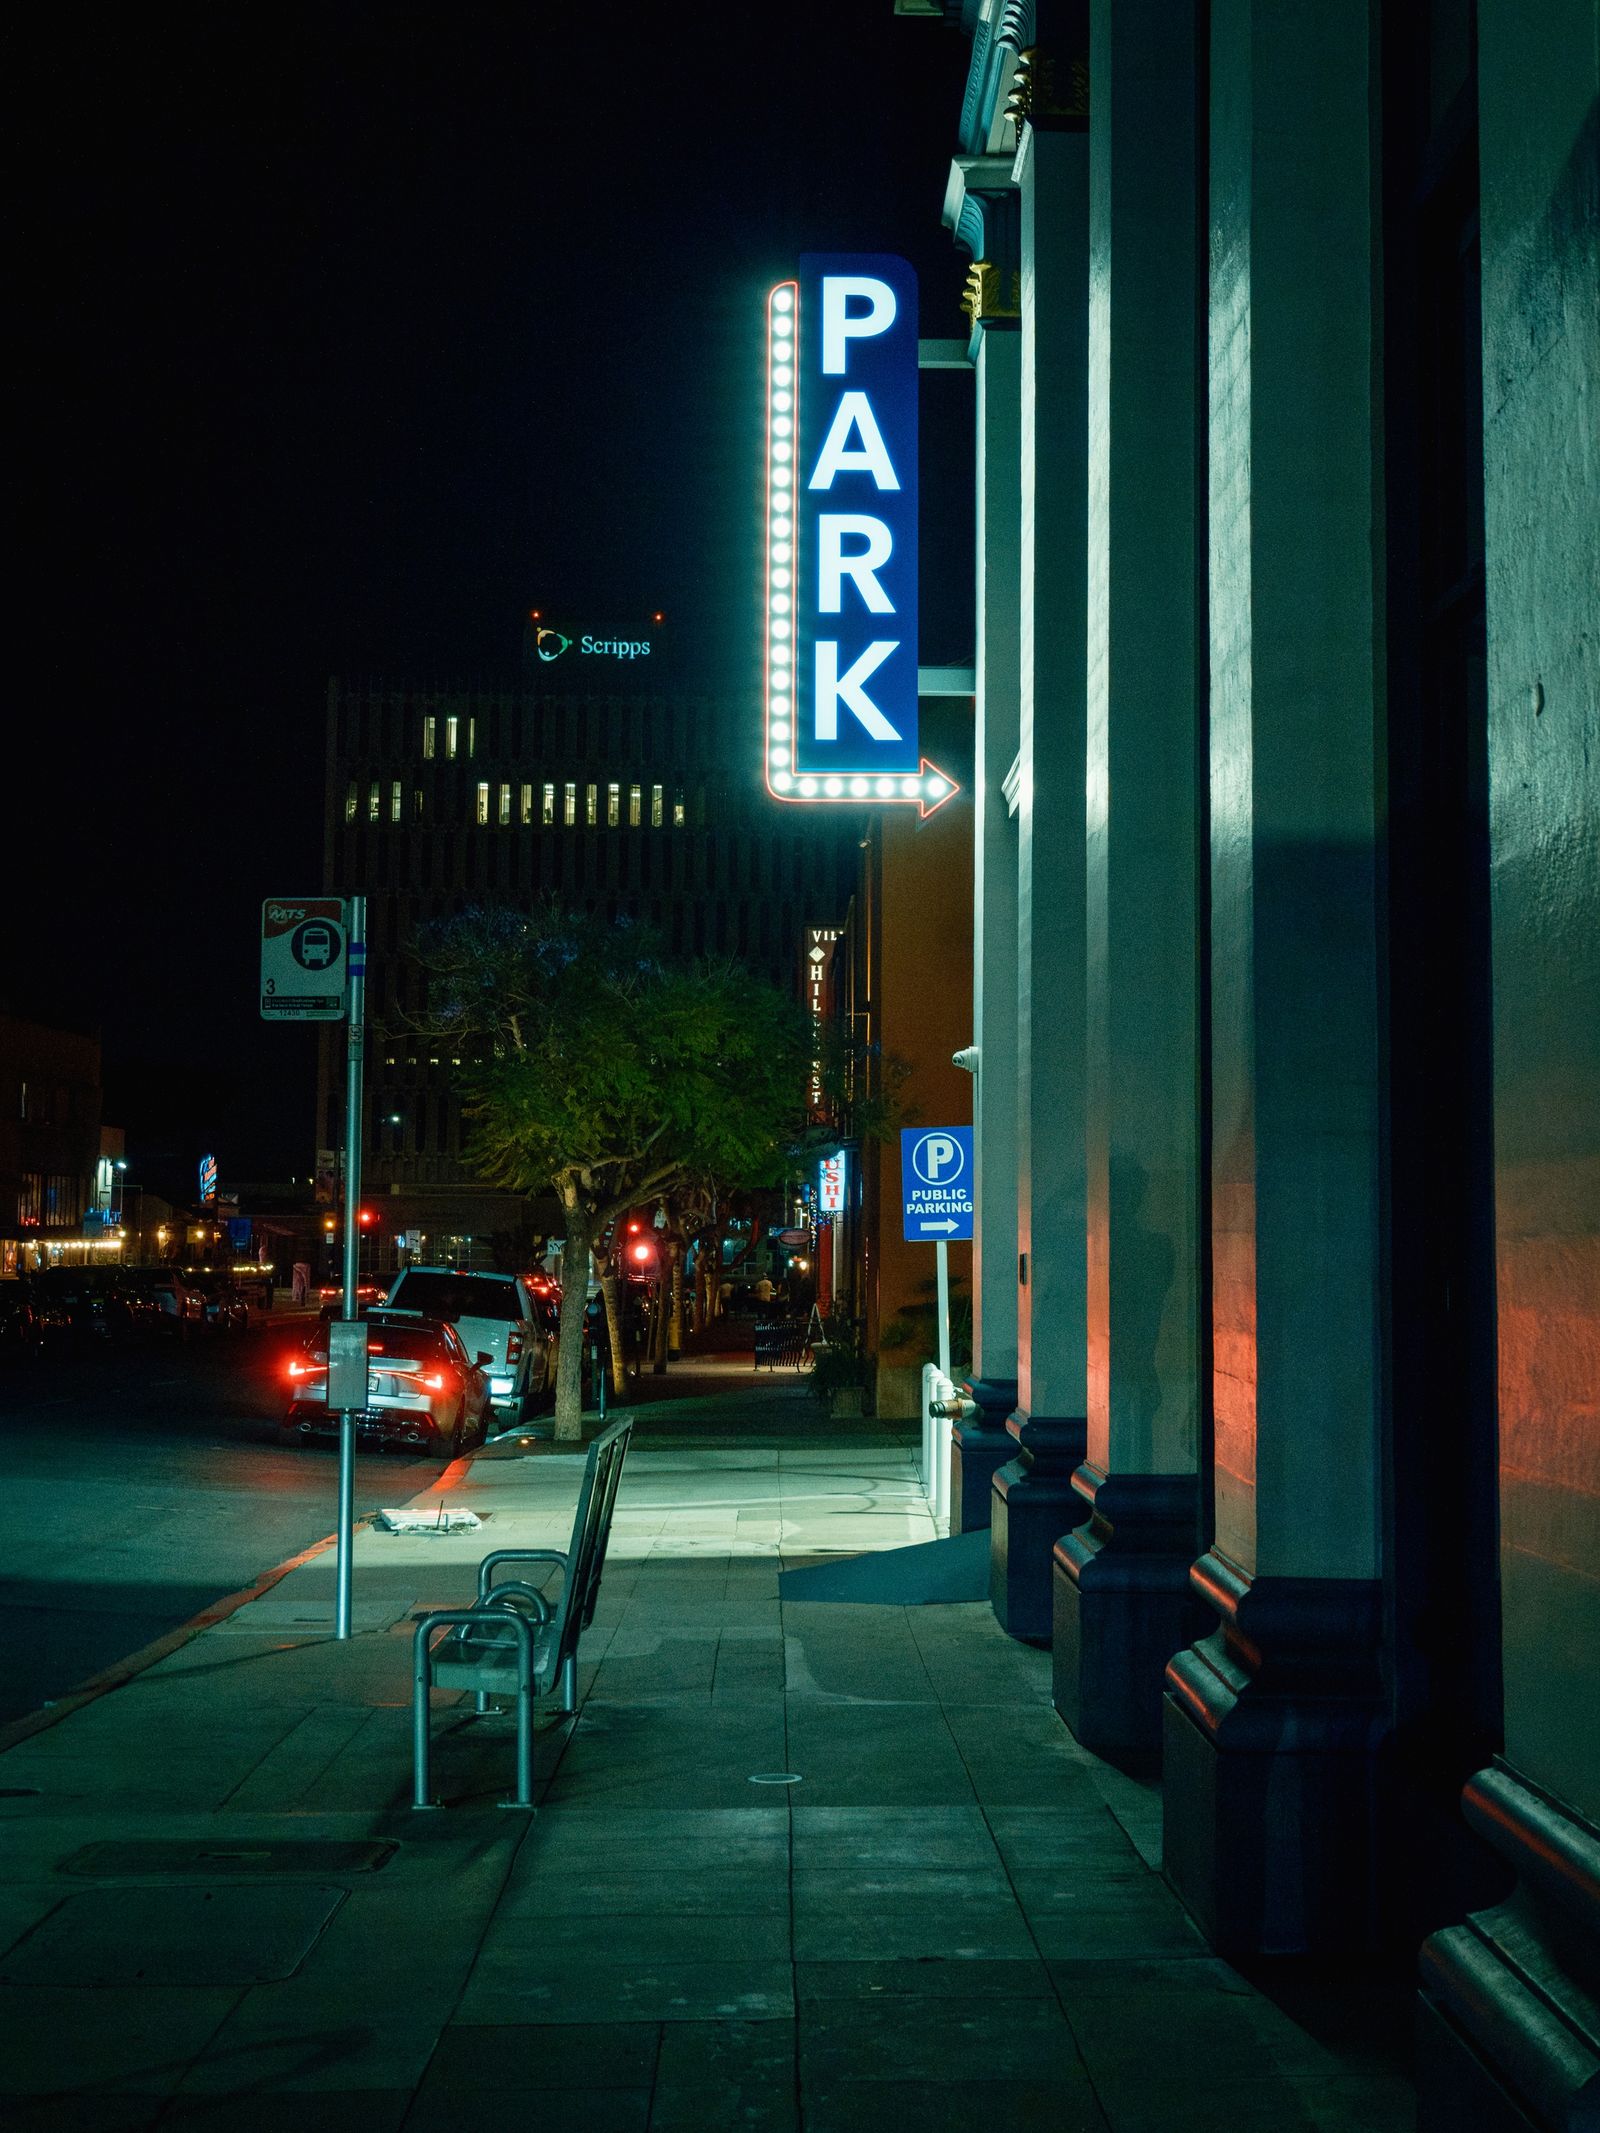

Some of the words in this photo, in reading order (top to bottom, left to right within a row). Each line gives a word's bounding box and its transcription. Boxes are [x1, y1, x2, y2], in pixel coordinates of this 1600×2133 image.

[808, 276, 903, 741] PARK
[581, 635, 651, 659] Scripps
[812, 931, 844, 943] VIL
[266, 978, 275, 995] 3
[927, 1139, 954, 1179] P
[911, 1189, 967, 1201] PUBLIC
[906, 1202, 973, 1215] PARKING
